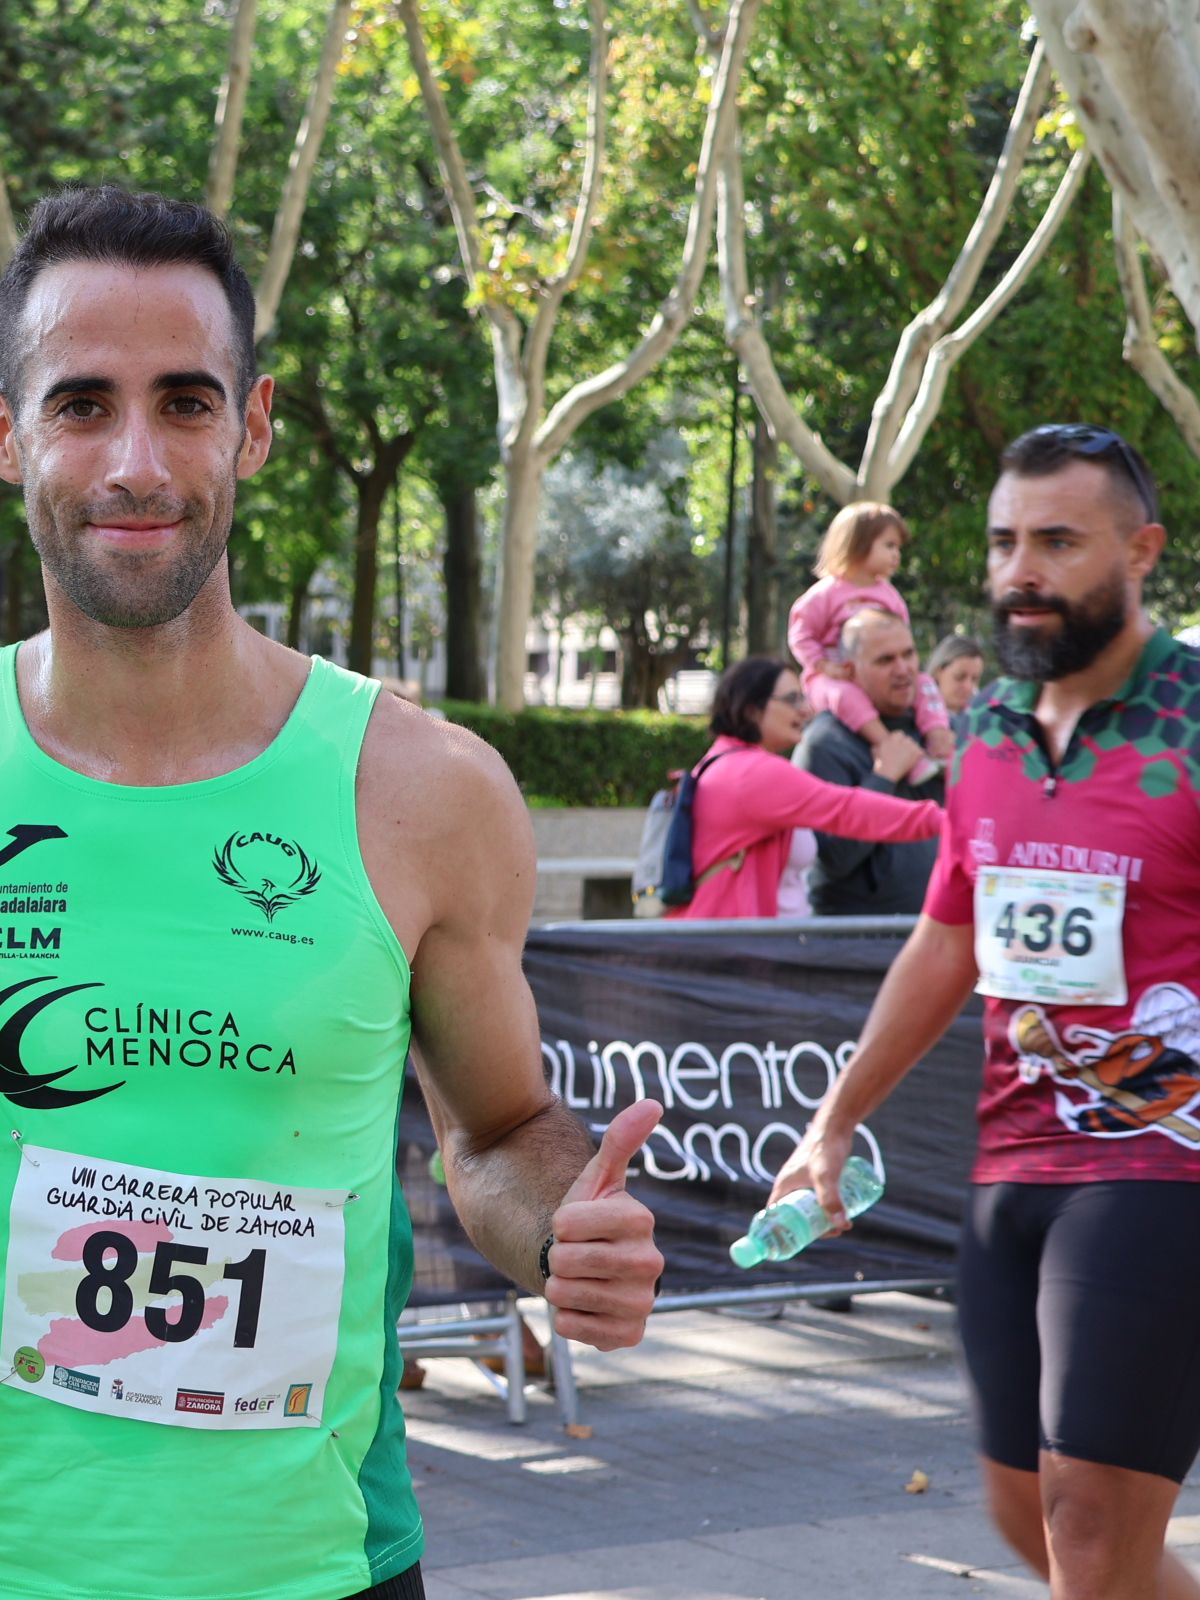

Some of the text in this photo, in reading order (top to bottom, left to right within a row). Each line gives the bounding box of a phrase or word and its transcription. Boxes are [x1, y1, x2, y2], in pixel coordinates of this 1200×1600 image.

[236, 832, 297, 857] CAUG
[55, 881, 68, 893] de
[231, 927, 314, 945] www.caug.es
[995, 901, 1094, 957] 436
[85, 1002, 239, 1037] CLÍNICA
[86, 1037, 296, 1075] MENORCA
[71, 1166, 296, 1211] VIII CARRERA POPULAR
[201, 1214, 229, 1231] DE
[236, 1217, 315, 1237] ZAMORA
[76, 1230, 267, 1348] 851
[134, 1396, 162, 1406] ZAMORA
[186, 1402, 221, 1411] ZAMORA
[234, 1398, 275, 1411] feder
